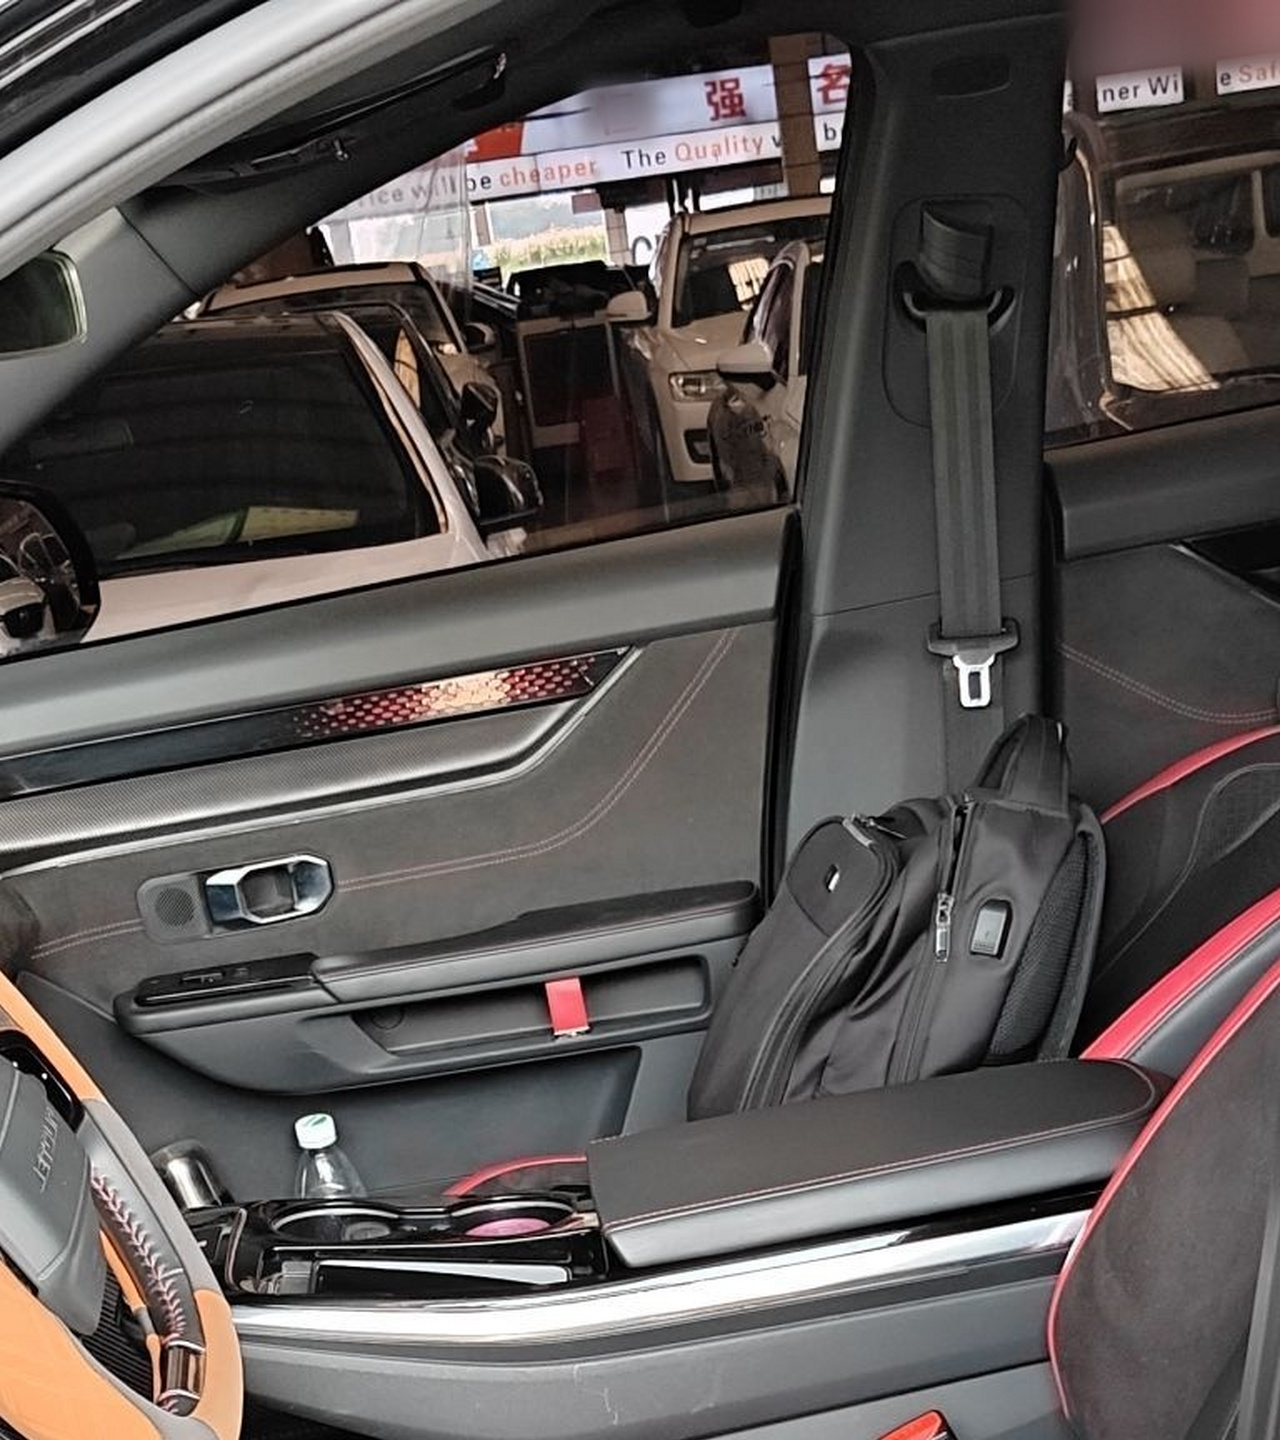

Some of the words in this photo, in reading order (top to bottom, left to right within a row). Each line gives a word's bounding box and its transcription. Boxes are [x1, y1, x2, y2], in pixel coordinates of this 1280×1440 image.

[1101, 83, 1141, 102] ner
[499, 160, 598, 187] cheaper
[621, 148, 667, 169] The
[675, 134, 764, 162] Quality
